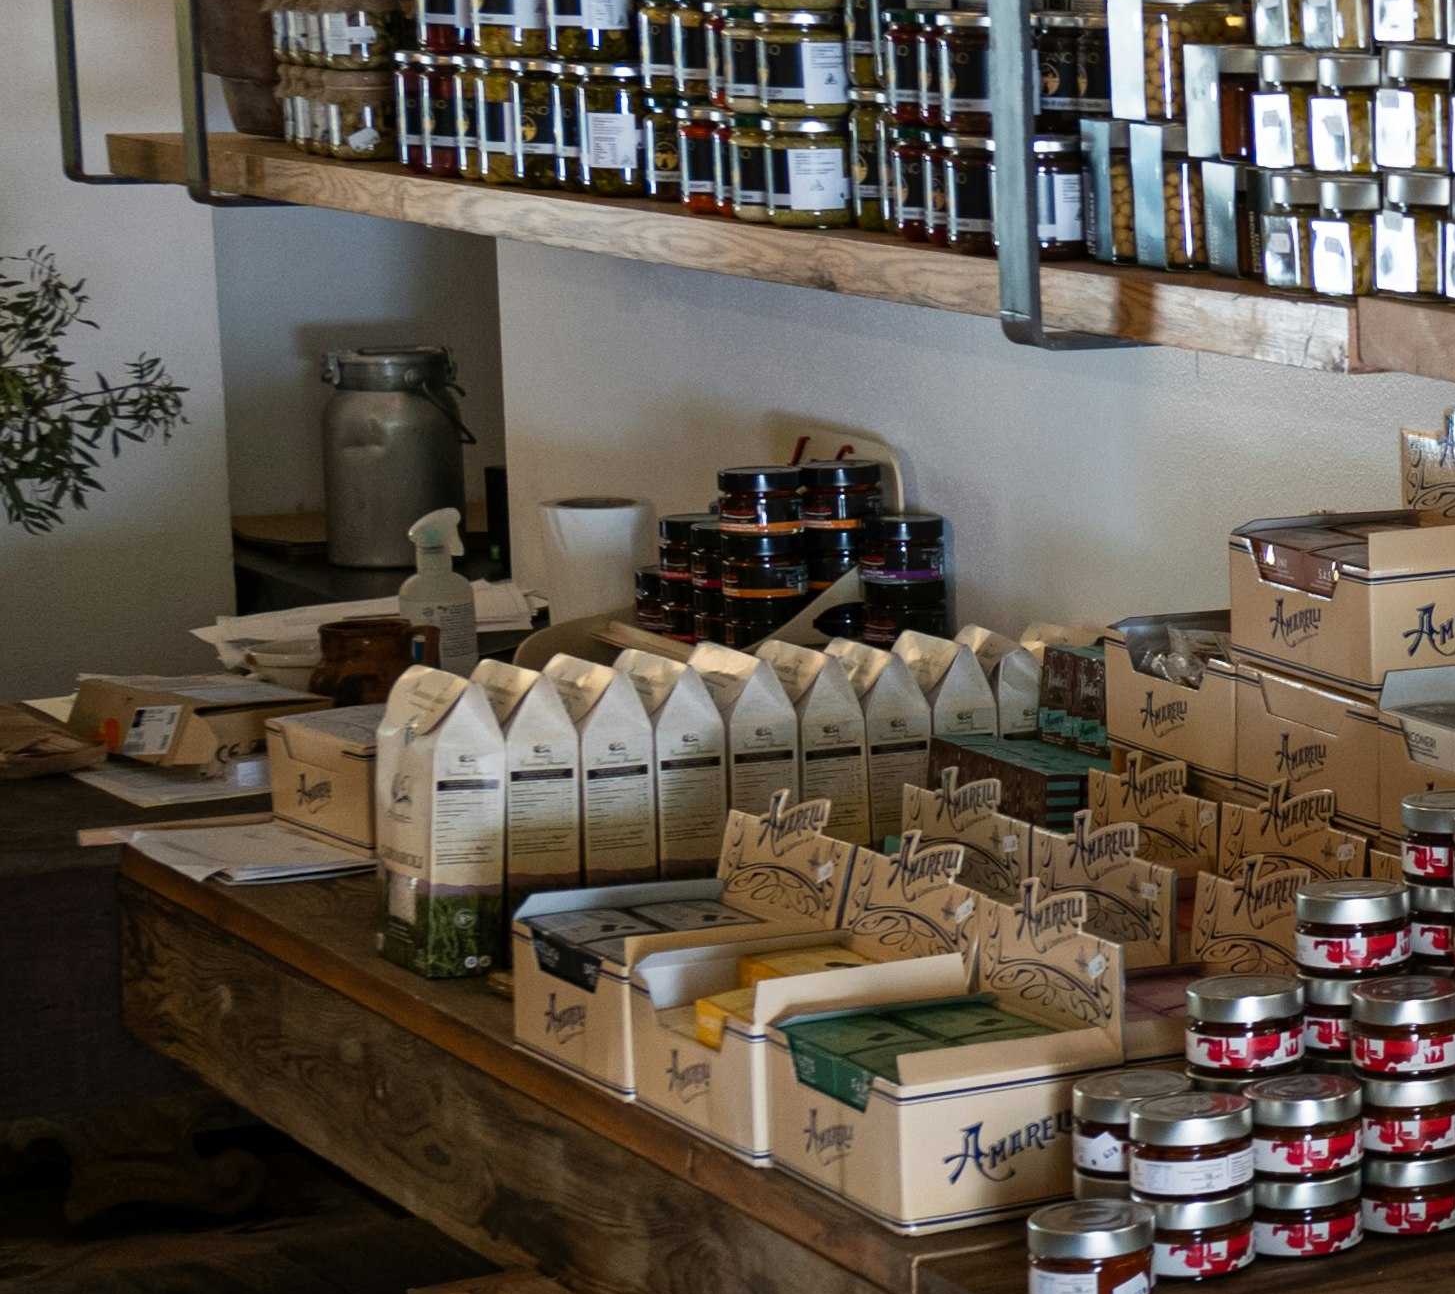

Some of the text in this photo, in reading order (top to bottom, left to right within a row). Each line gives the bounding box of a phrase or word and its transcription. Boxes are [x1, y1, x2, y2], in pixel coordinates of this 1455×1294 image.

[1270, 598, 1322, 645] AMARELLI
[1140, 691, 1188, 738] AMARELLI
[1121, 757, 1185, 817] AMARELLI
[1275, 733, 1327, 781] AMARELLI
[934, 769, 996, 832] AMARELLI
[1067, 814, 1136, 881] AMARELLI
[1015, 880, 1083, 952] AMARELLI
